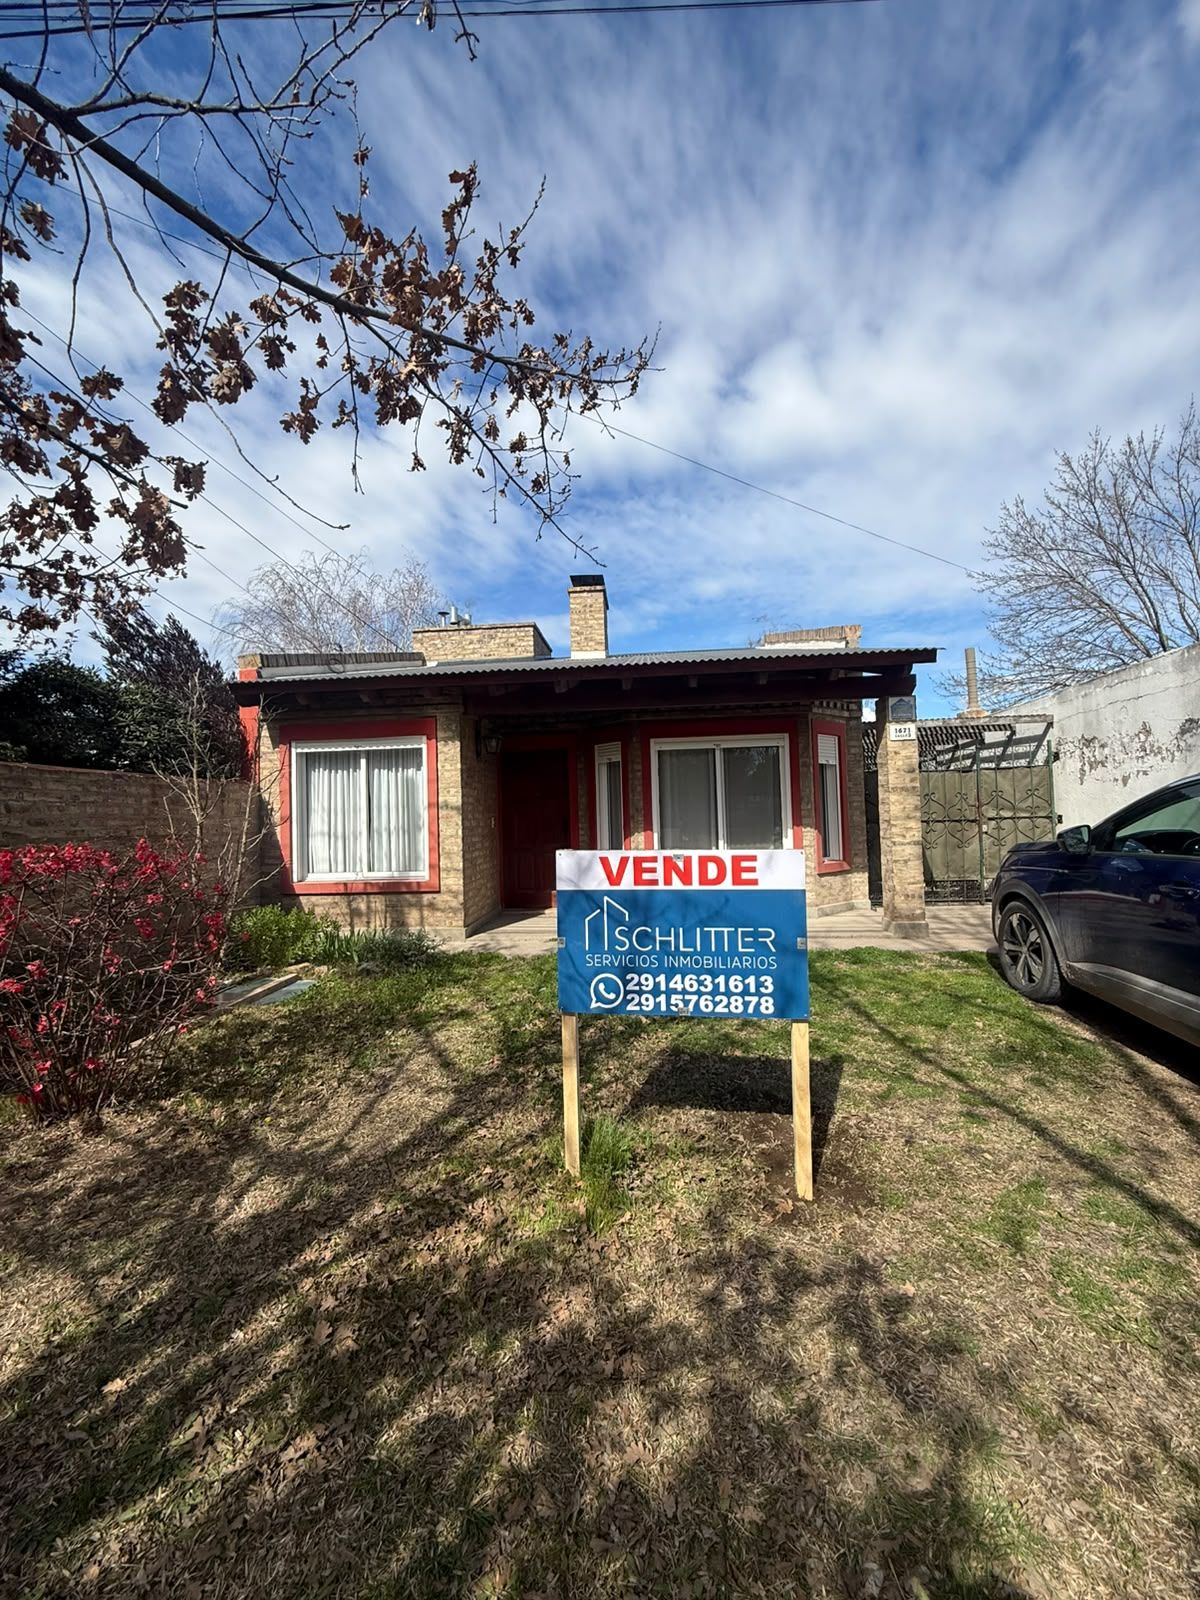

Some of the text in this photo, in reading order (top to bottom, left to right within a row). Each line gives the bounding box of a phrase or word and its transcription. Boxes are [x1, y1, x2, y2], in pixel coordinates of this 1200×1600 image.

[599, 855, 759, 886] VENDE
[614, 926, 777, 952] SCHLITTER
[586, 954, 777, 969] SERVICIOS INMOBILIARIOS
[626, 973, 774, 993] 2914631613
[626, 993, 774, 1014] 2915762878
